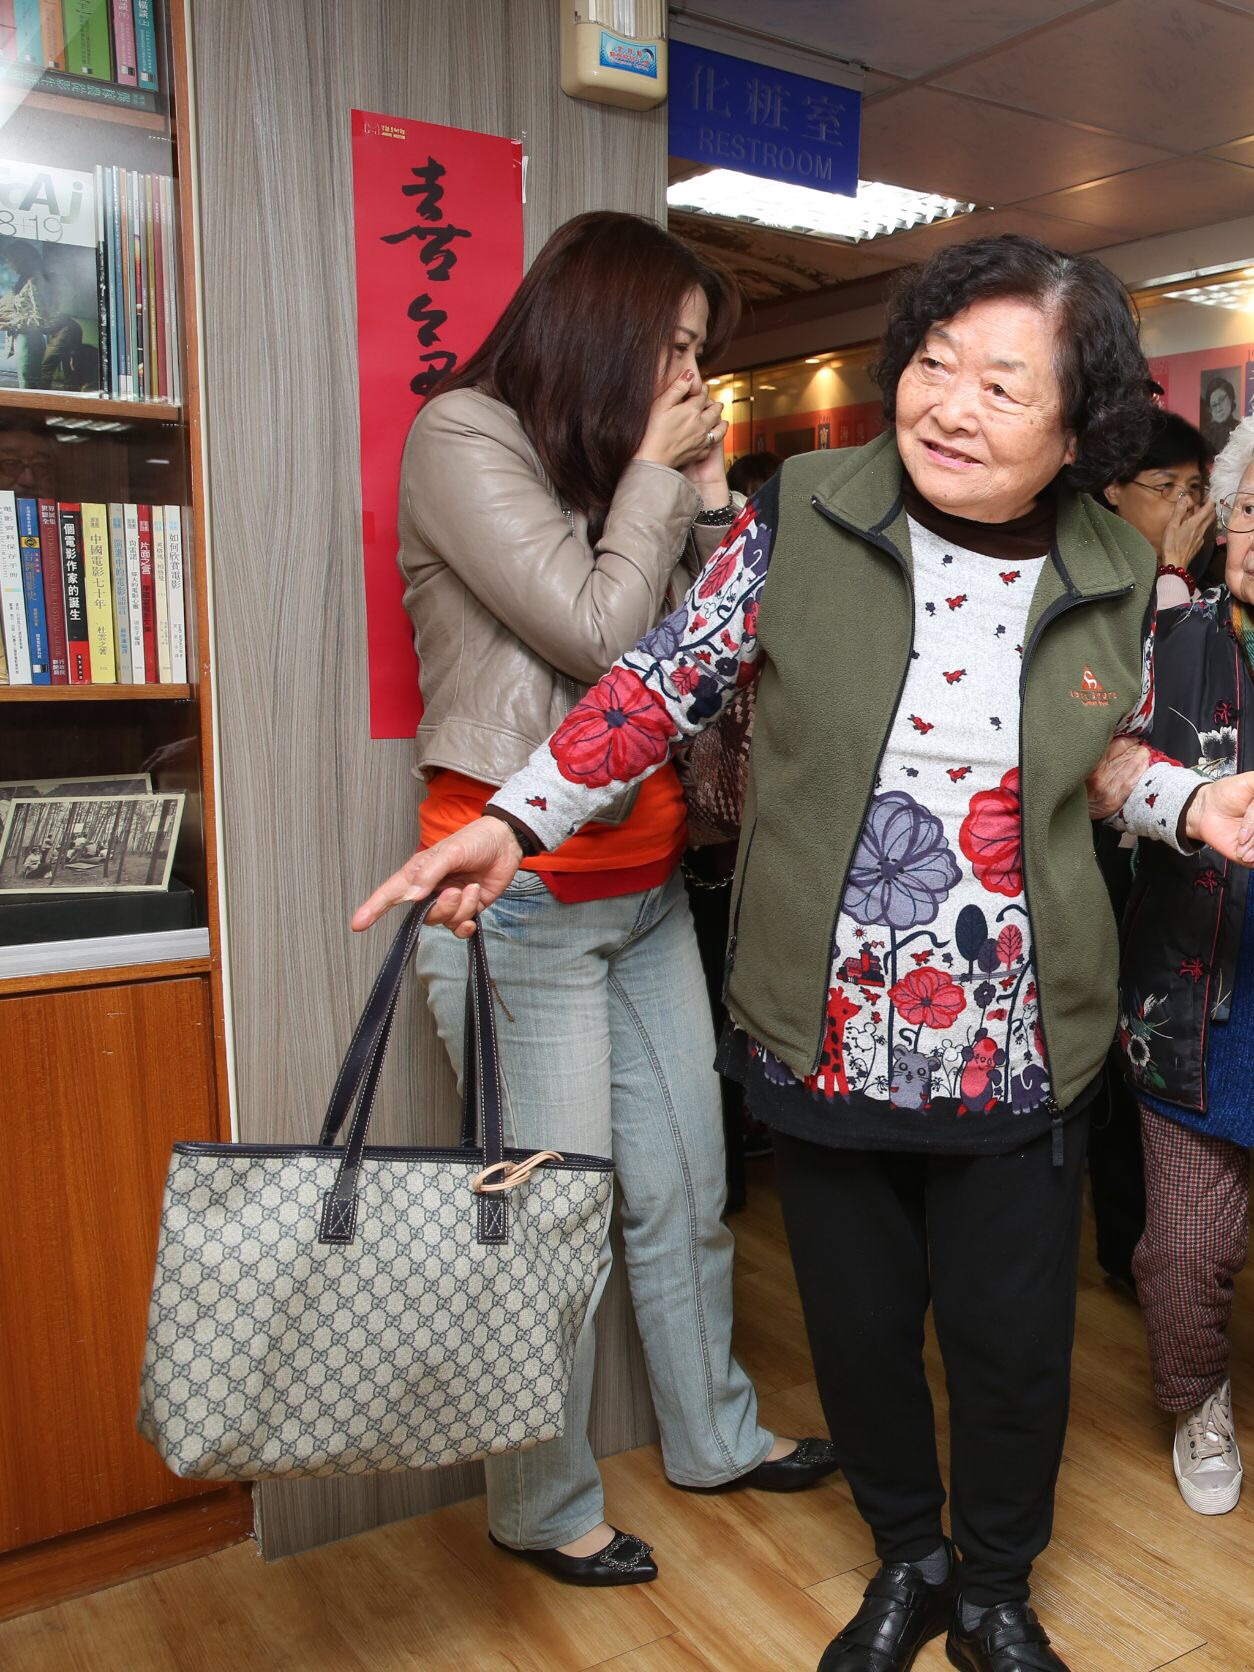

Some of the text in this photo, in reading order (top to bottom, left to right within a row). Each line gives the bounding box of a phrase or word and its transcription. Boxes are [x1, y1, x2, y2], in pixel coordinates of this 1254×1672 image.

[699, 128, 833, 182] RESTROOM
[62, 514, 82, 621] 一個電影作家的誕生
[90, 533, 107, 610] 中國電影七十年
[170, 534, 185, 589] 如何欣賞電影
